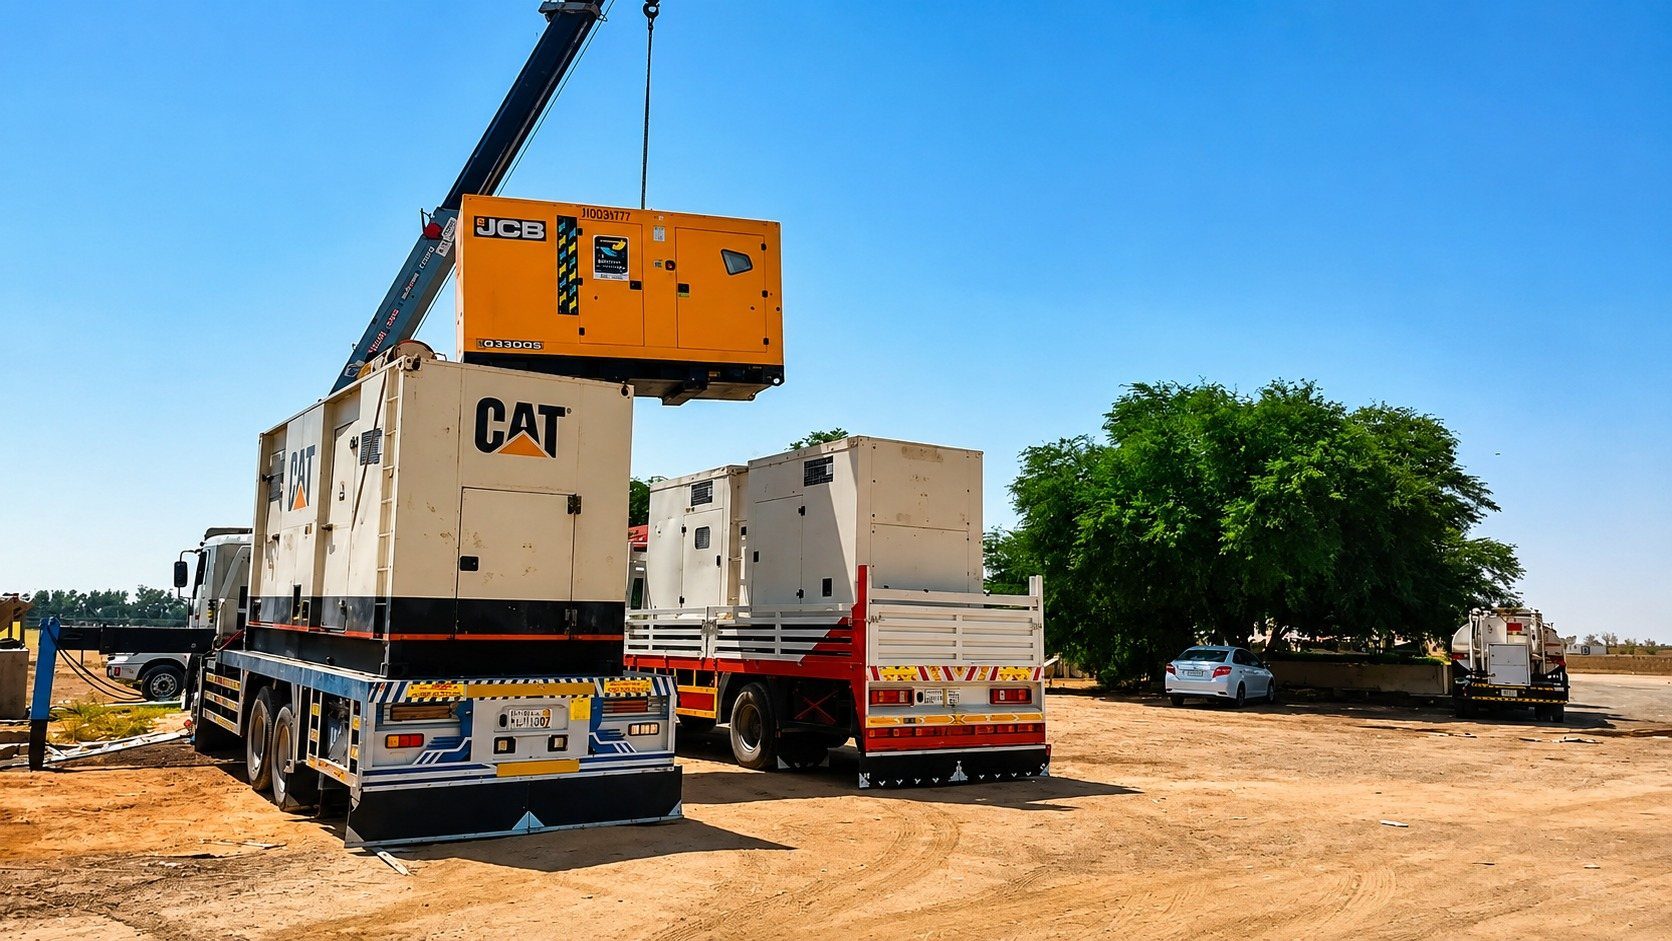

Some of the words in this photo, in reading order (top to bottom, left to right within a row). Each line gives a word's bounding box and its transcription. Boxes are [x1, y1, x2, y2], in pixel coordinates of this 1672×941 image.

[476, 218, 545, 239] JCB
[474, 396, 566, 459] CAT
[287, 444, 316, 512] CAT
